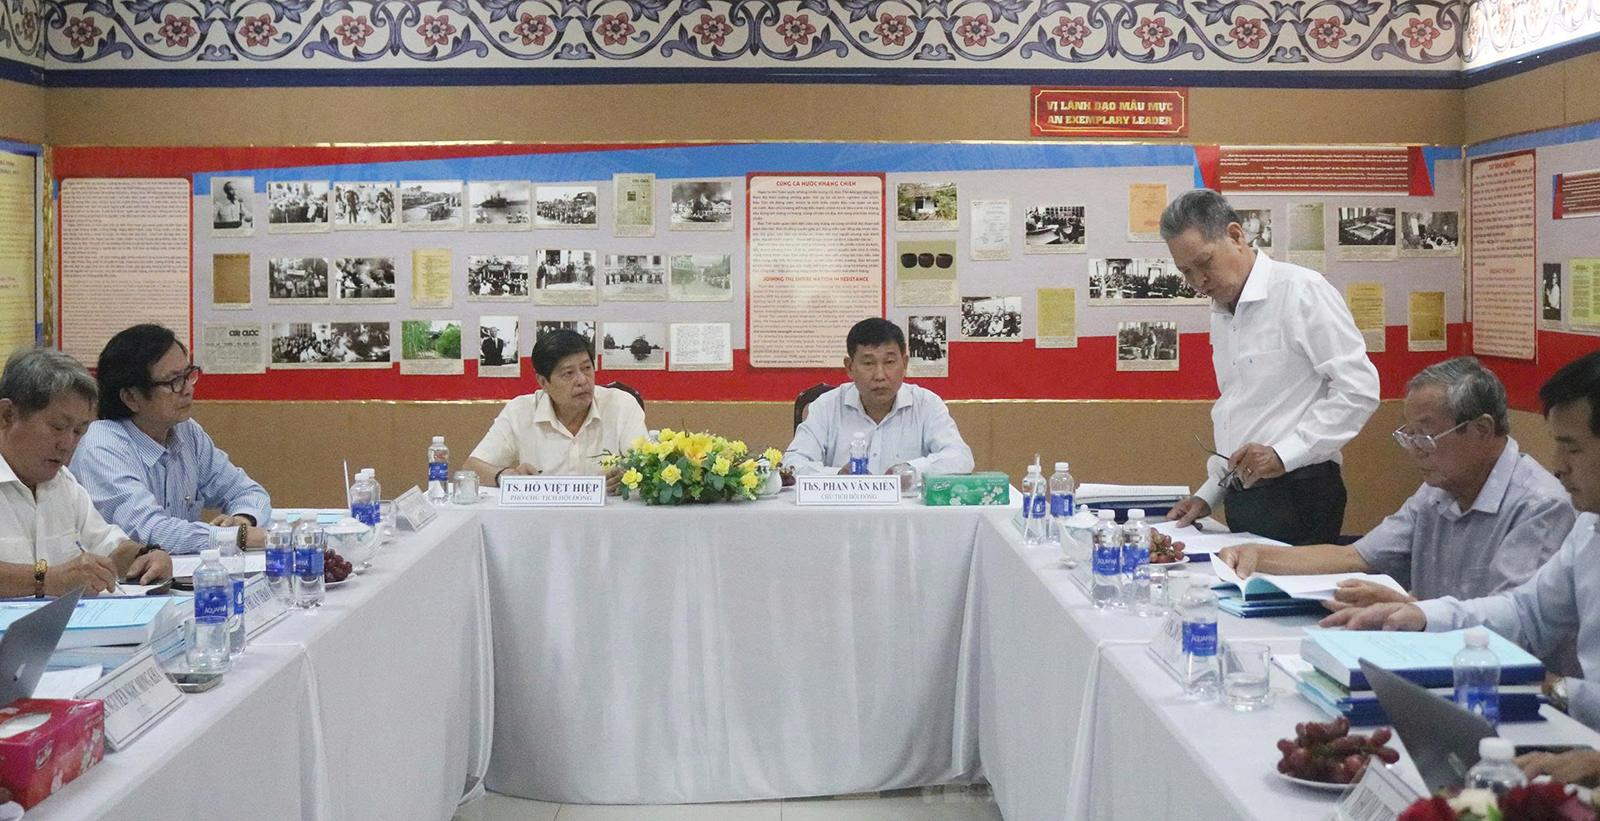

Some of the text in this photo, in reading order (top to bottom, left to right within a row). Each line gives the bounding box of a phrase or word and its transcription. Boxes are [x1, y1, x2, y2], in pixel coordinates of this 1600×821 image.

[1047, 115, 1173, 125] AN EXEMPLARY LEADER
[506, 483, 522, 492] TS.
[544, 482, 570, 494] VIỆT
[802, 482, 821, 491] ThS.
[823, 482, 848, 491] PHAN
[850, 480, 870, 491] VĂN
